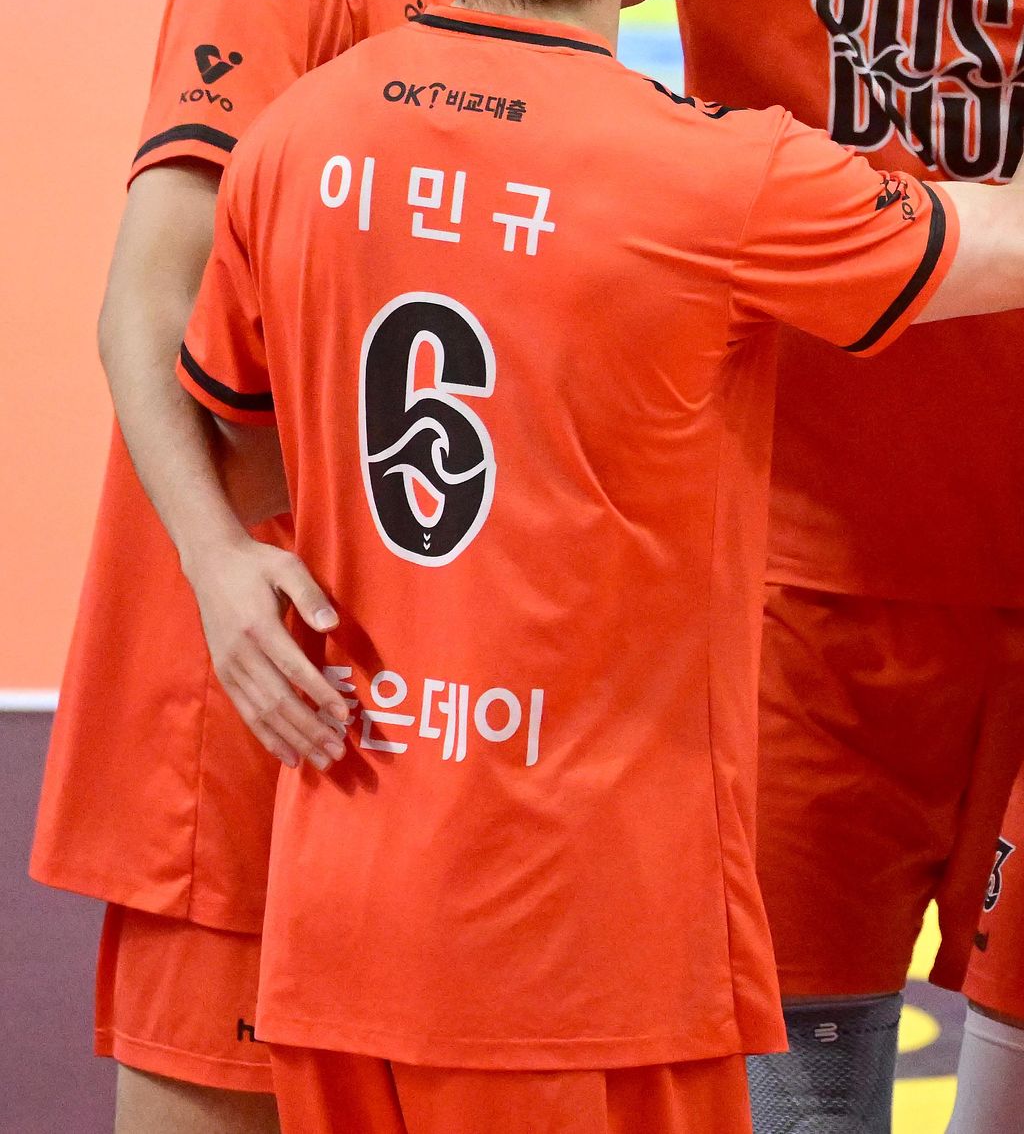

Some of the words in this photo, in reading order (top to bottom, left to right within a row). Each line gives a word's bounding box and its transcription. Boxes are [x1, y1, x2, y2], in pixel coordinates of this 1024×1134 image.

[179, 88, 234, 113] KOVO
[445, 89, 527, 122] 비교대출
[319, 154, 556, 256] 이민규
[359, 291, 497, 567] 6
